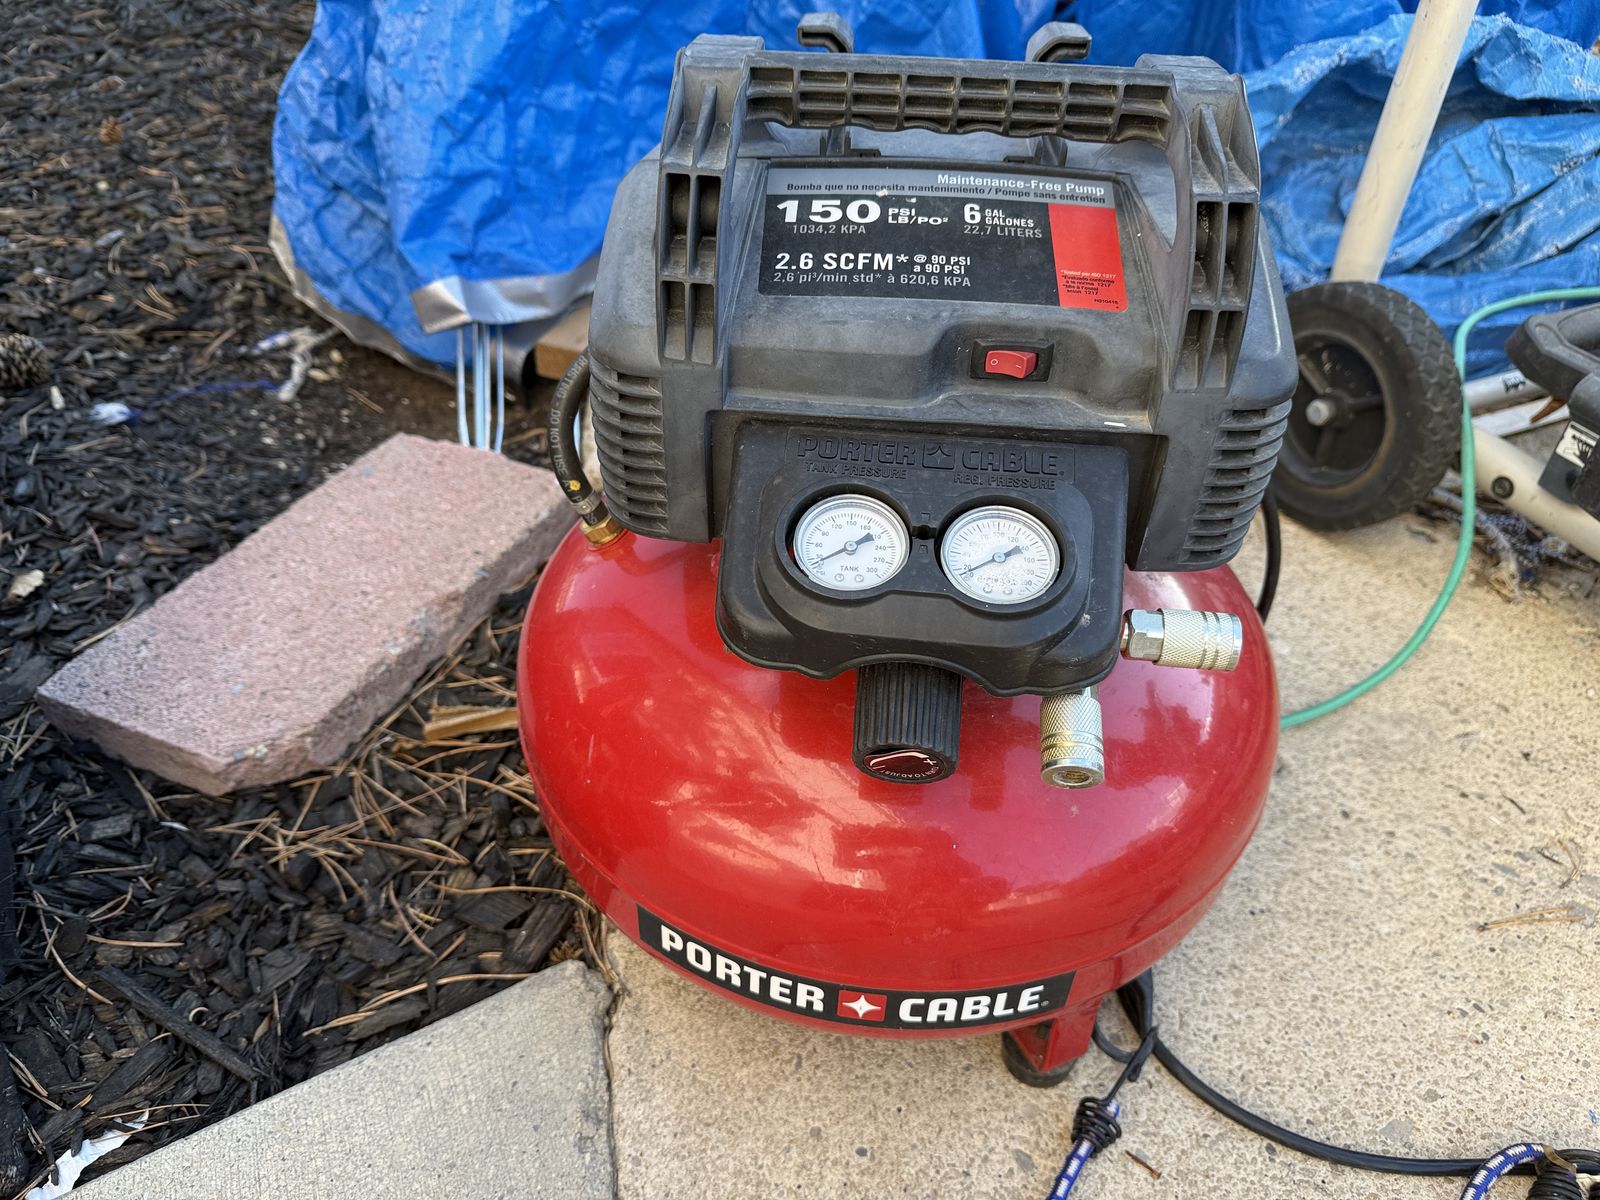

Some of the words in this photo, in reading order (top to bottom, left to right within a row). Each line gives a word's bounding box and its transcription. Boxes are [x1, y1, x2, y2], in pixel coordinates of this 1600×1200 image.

[787, 183, 822, 191] Bomba
[825, 184, 843, 192] que
[861, 184, 907, 192] necesita
[908, 185, 985, 195] mantenimiento
[995, 188, 1031, 198] Pompe
[1033, 191, 1057, 200] sans
[1059, 193, 1106, 204] entretien
[938, 174, 1061, 191] Maintenance-Free
[1066, 183, 1105, 196] Pump
[777, 200, 881, 224] 150
[888, 208, 916, 216] PSI
[964, 203, 982, 224] 6
[985, 208, 1005, 217] GAL
[841, 225, 866, 234] KPA
[985, 216, 1035, 227] GALONES
[997, 227, 1043, 239] LITERS
[774, 252, 814, 270] 2.6
[913, 254, 927, 264] @
[931, 254, 946, 264] 90
[950, 256, 971, 266] PSI
[925, 264, 940, 273] 90
[944, 265, 965, 274] PSI
[944, 276, 971, 287] KPA
[550, 408, 561, 424] DO
[550, 424, 562, 449] NOT
[552, 453, 568, 476] USE
[797, 434, 916, 466] PORTER
[962, 446, 1058, 477] CABLE
[804, 461, 839, 475] TANK
[841, 463, 907, 480] PRESSURE
[954, 473, 983, 486] REG.
[988, 475, 1057, 491] PRESSURE
[814, 541, 823, 549] 60
[866, 566, 878, 574] 300
[879, 769, 913, 778] ADJUST
[660, 924, 826, 1012] PORTER
[898, 984, 1045, 1023] CABLE
